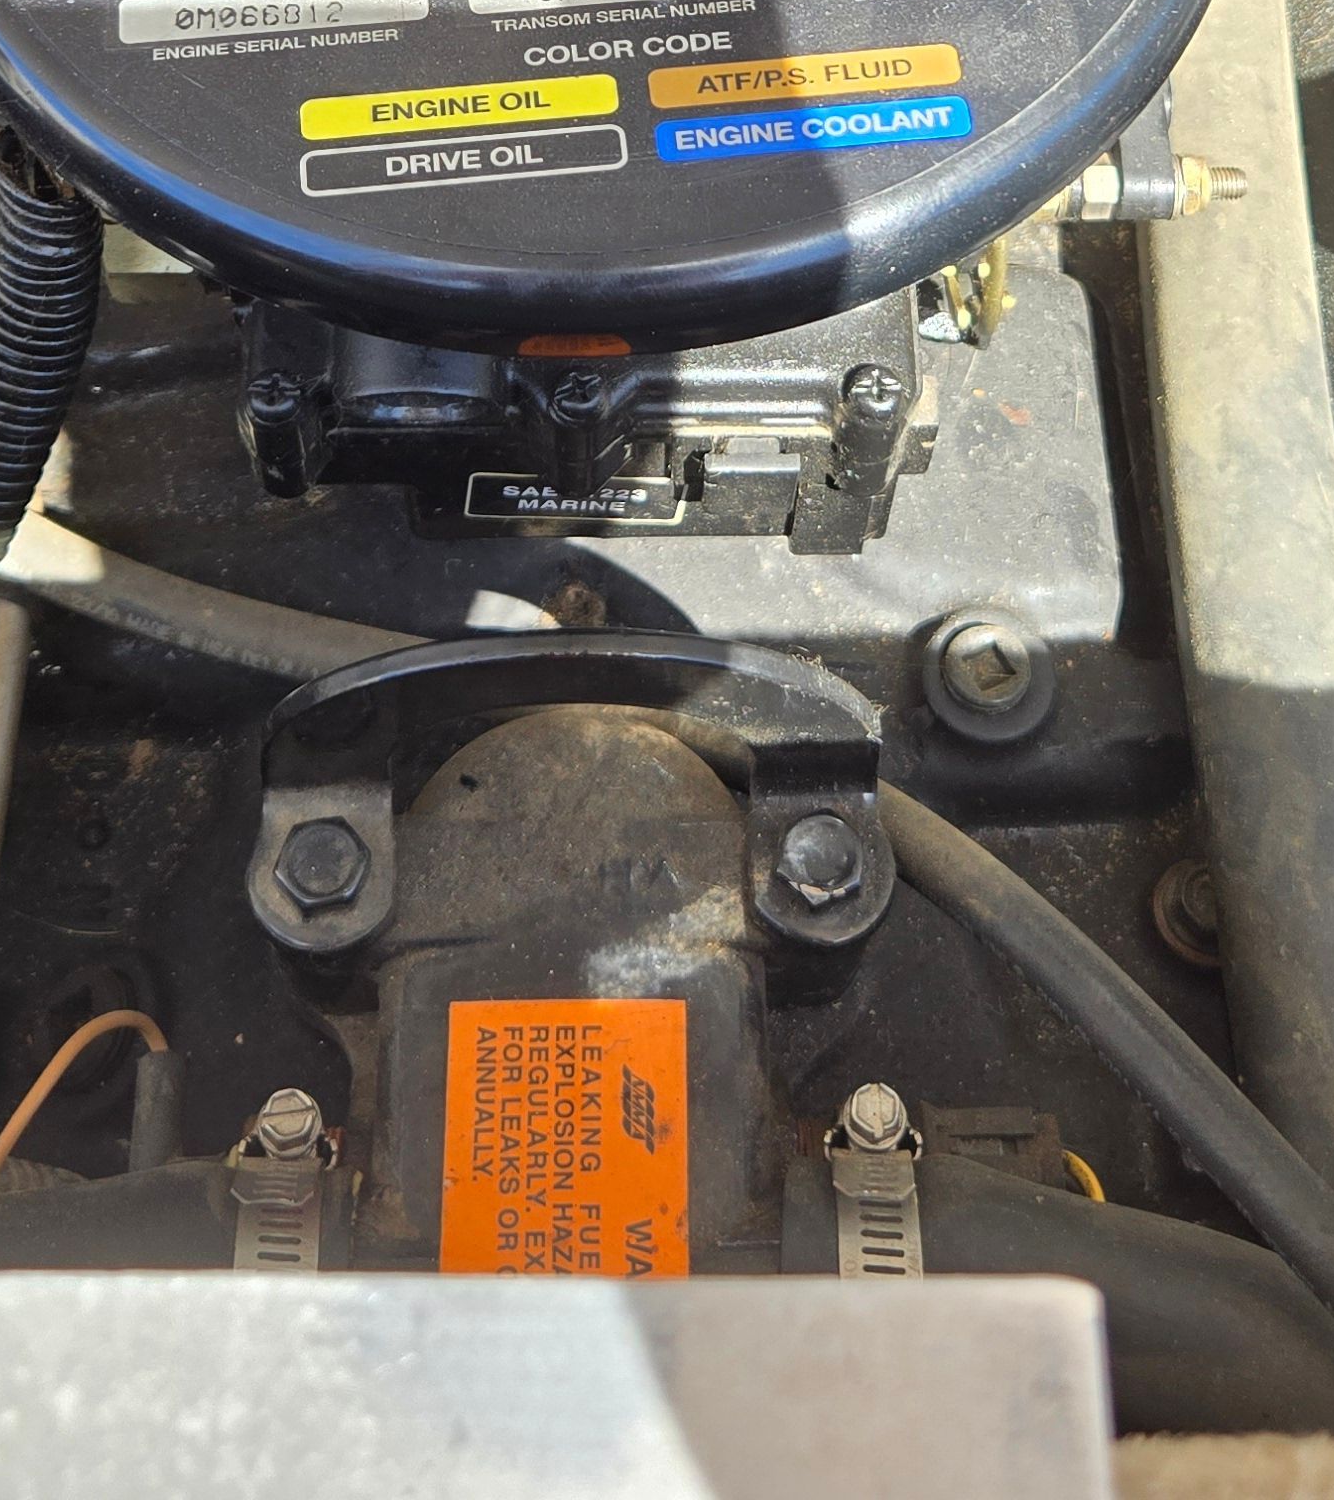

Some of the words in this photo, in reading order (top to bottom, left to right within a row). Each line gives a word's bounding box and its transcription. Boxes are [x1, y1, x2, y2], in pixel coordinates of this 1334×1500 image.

[490, 12, 592, 33] TRANSOM
[595, 5, 666, 23] SERIAL
[152, 43, 230, 62] ENGINE
[233, 36, 307, 55] SERIAL
[311, 28, 400, 48] NUMBER
[523, 39, 635, 67] COLOR
[642, 30, 734, 58] CODE
[697, 67, 815, 95] ATF/P.S.
[824, 59, 913, 82] FLUID
[371, 95, 491, 123] ENGINE
[499, 90, 551, 111] OIL
[675, 120, 795, 151] ENGINE
[801, 106, 954, 139] COOLANT
[385, 150, 482, 177] DRIVE
[489, 144, 544, 168] OIL
[503, 486, 557, 497] SAE
[517, 499, 625, 512] MARINE
[501, 1026, 523, 1084] FOR
[472, 1026, 497, 1182] ANNUALLY.
[524, 1025, 549, 1212] REGULARLY.
[553, 1025, 575, 1190] EXPLOSION
[579, 1025, 602, 1173] LEAKING
[498, 1097, 521, 1194] LEAKS
[496, 1209, 519, 1251] OR
[578, 1203, 601, 1269] FUE
